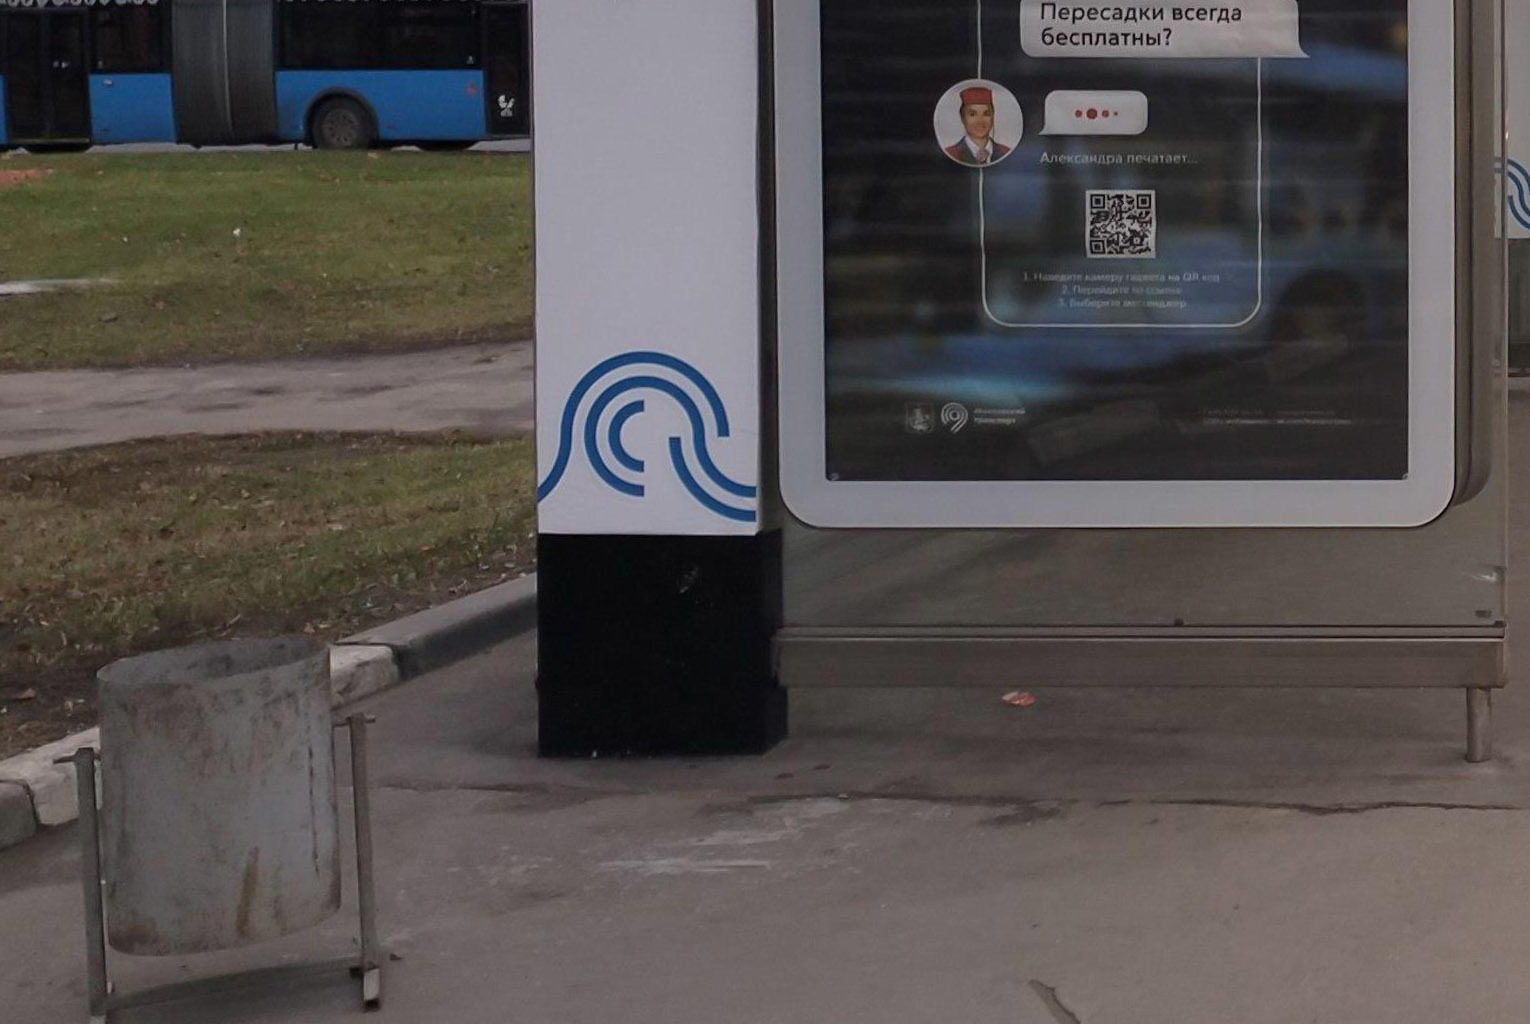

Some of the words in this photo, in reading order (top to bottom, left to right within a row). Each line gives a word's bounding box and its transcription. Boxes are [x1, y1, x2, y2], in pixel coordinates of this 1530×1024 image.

[1040, 3, 1164, 23] Пересадки
[1172, 5, 1242, 24] всегда
[1041, 28, 1172, 47] бесплатны?
[1040, 152, 1123, 165] Александра
